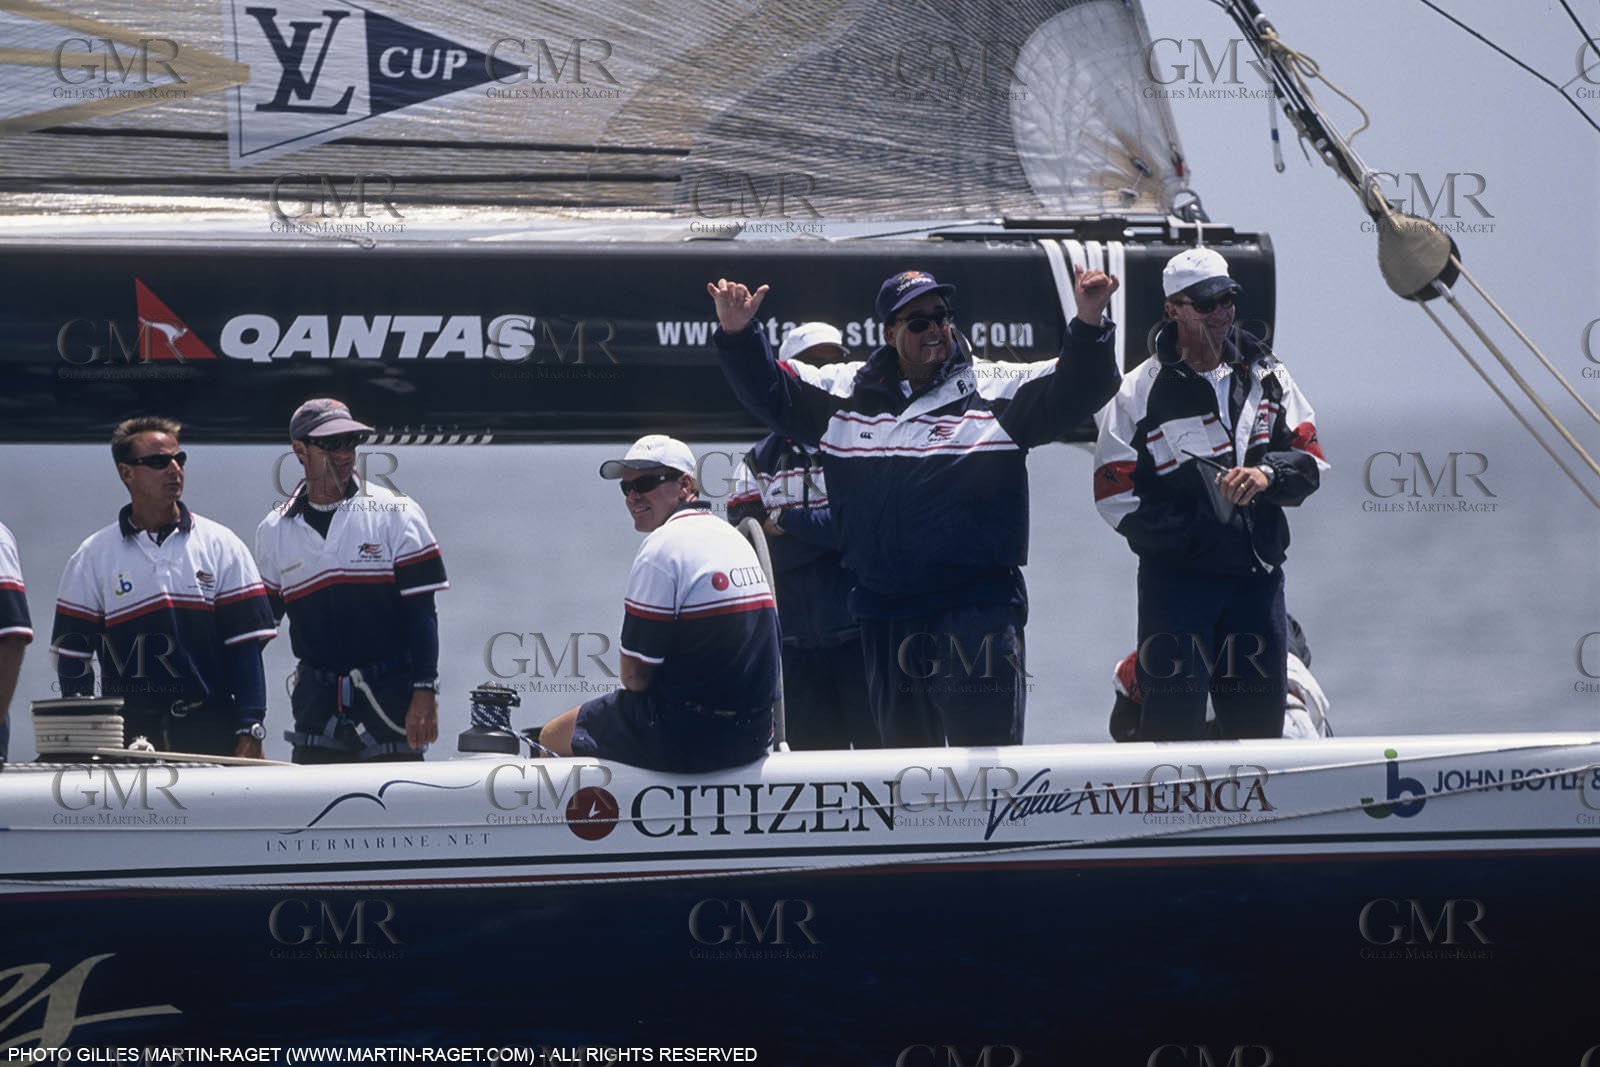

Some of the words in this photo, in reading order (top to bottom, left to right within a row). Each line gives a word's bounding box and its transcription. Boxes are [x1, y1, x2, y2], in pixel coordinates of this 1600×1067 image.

[379, 46, 468, 80] CUP
[219, 314, 536, 363] QANTAS
[1432, 769, 1504, 793] JOHN
[630, 780, 901, 838] CITIZEN
[984, 768, 1078, 841] Value
[1070, 779, 1270, 816] AMERICA
[266, 832, 492, 852] INTERMARINE.NET
